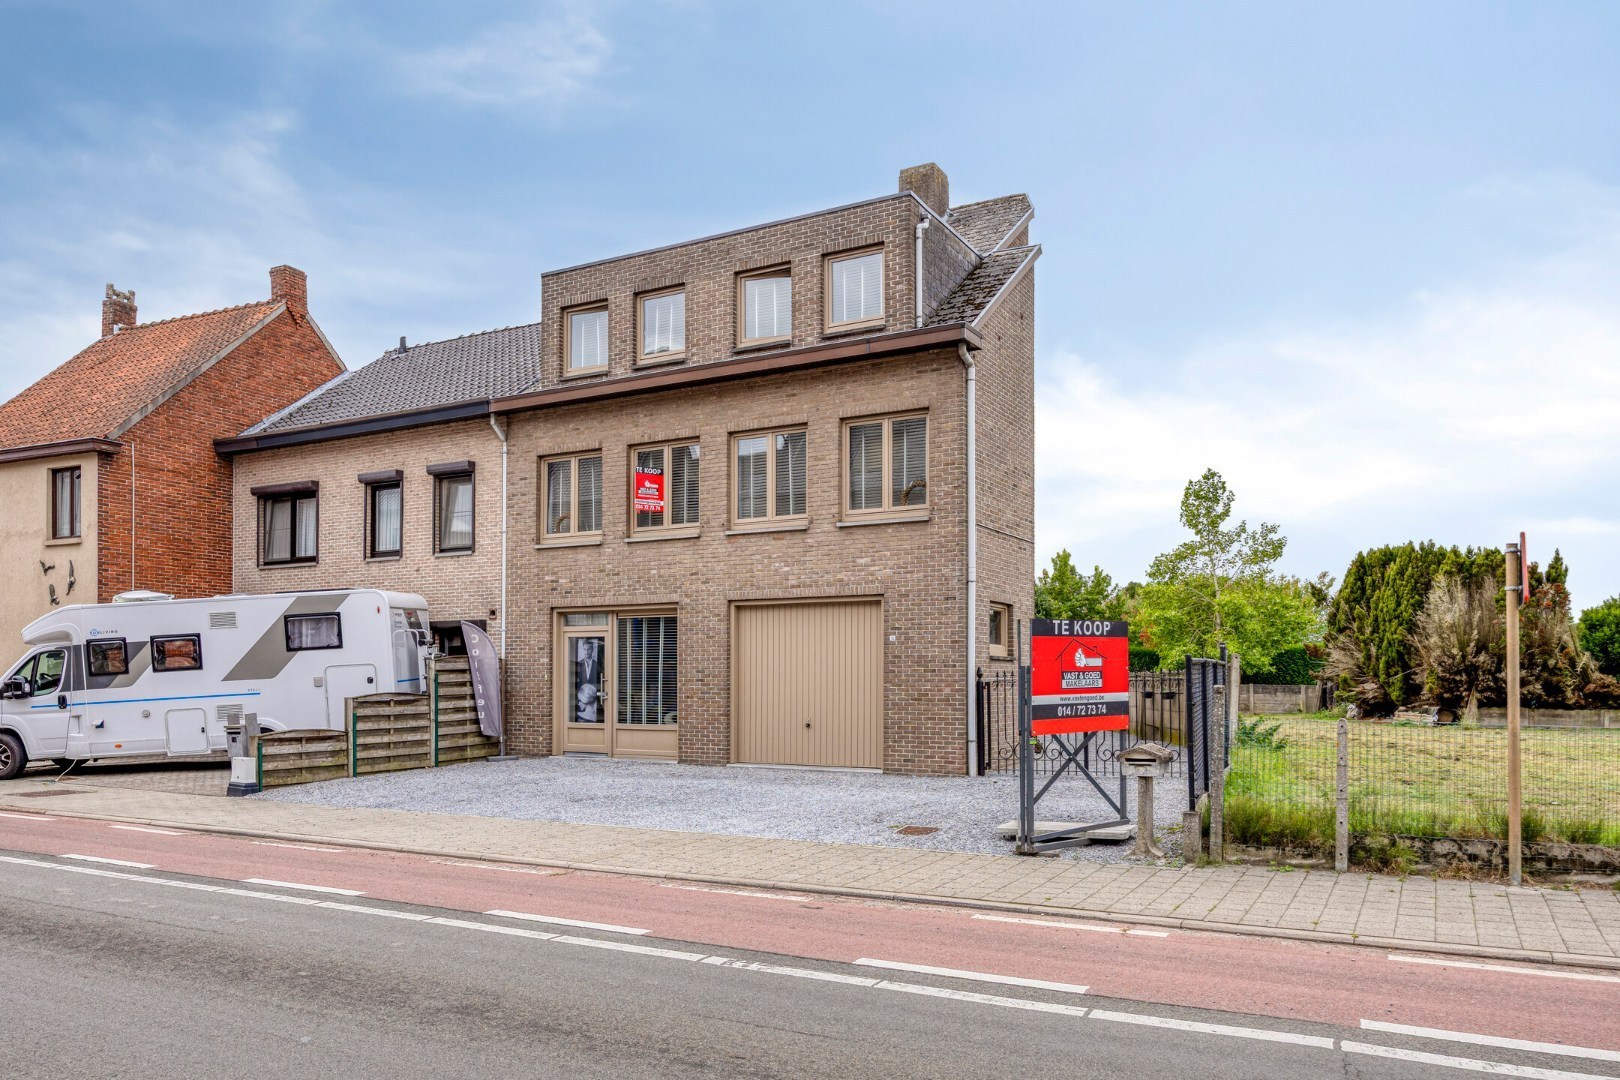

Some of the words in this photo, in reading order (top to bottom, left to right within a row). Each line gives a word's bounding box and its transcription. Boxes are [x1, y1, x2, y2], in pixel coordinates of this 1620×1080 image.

[1053, 620, 1069, 635] TE
[1074, 620, 1111, 635] KOOP
[1063, 672, 1078, 680] VAST
[1079, 672, 1084, 680] &
[1084, 671, 1101, 680] GOED
[1057, 706, 1071, 717] 014
[1076, 705, 1086, 716] 72
[1087, 704, 1096, 715] 73
[1097, 704, 1107, 714] 74
